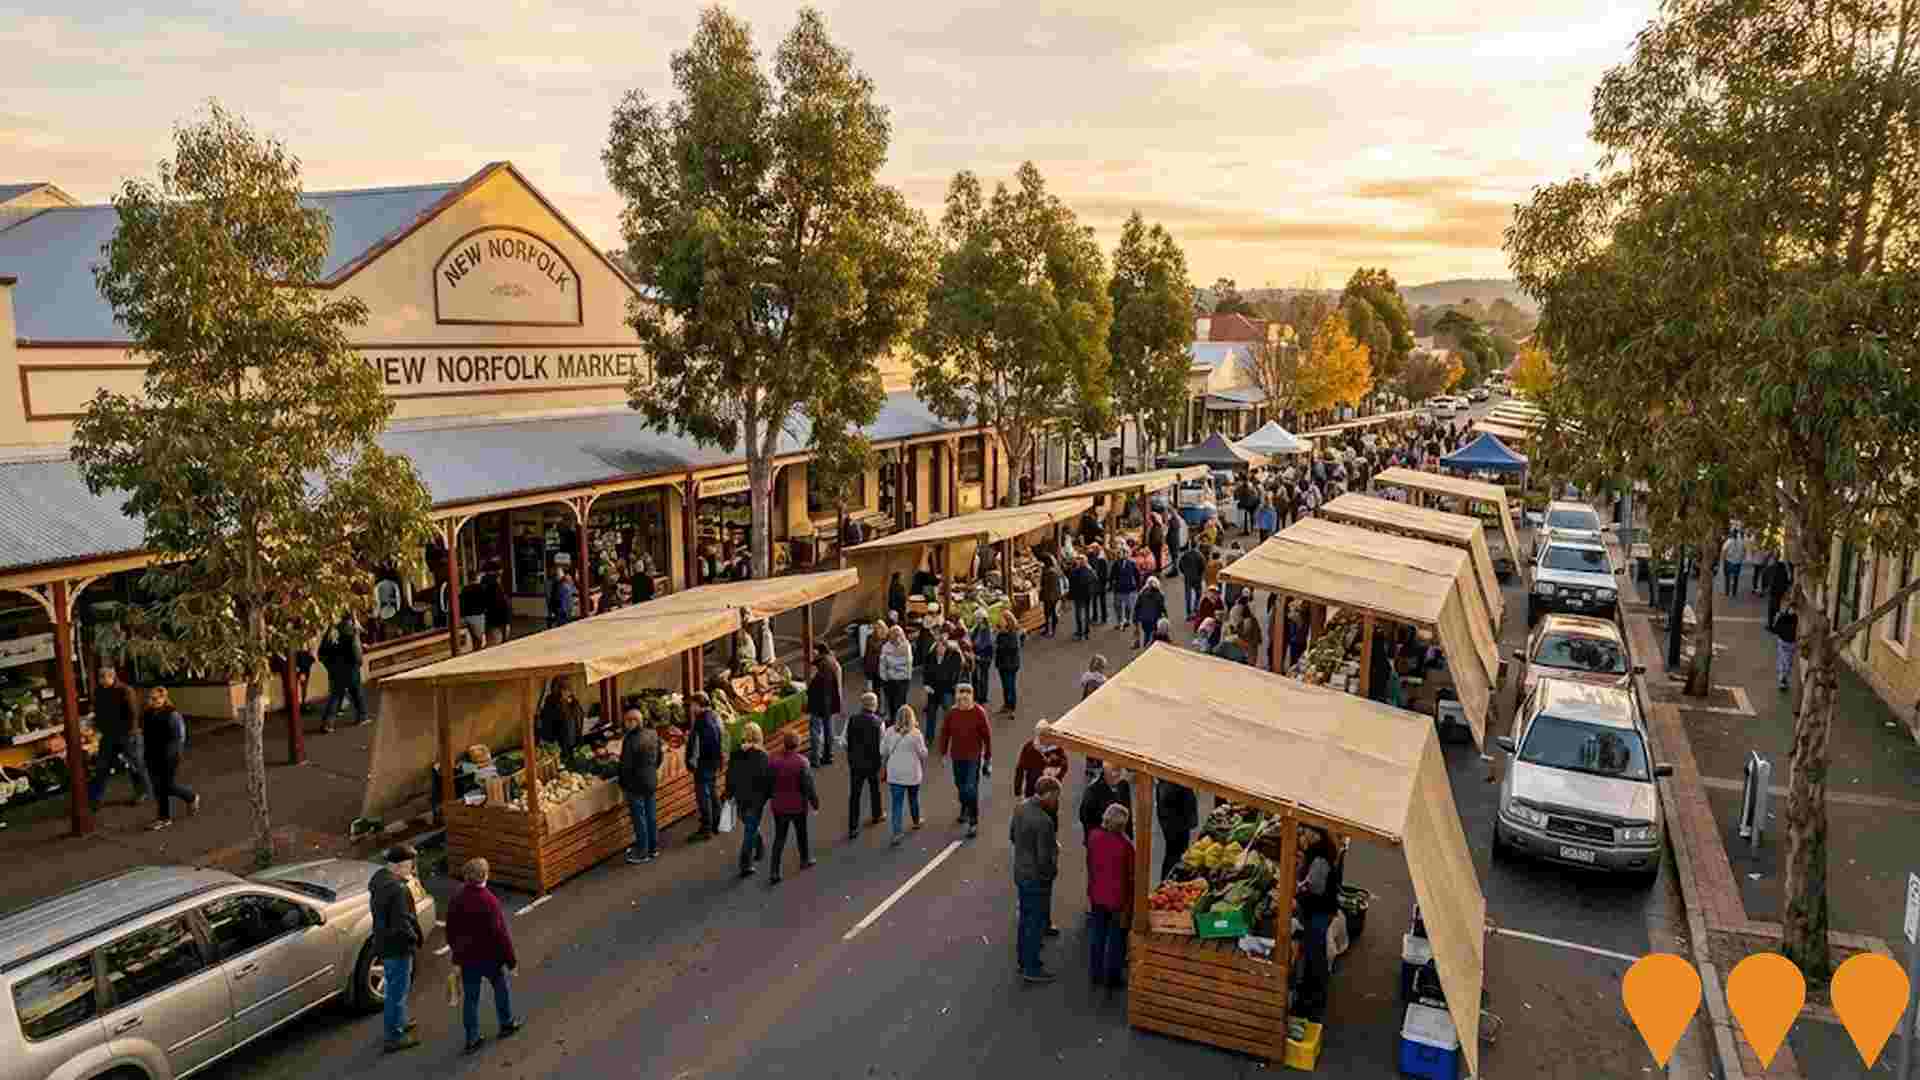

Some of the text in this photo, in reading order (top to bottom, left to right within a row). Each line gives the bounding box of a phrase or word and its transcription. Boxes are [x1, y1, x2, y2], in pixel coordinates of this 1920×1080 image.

[443, 238, 570, 293] NEW NORFOLK
[437, 355, 549, 383] NORFOLK
[558, 353, 638, 378] MARKET
